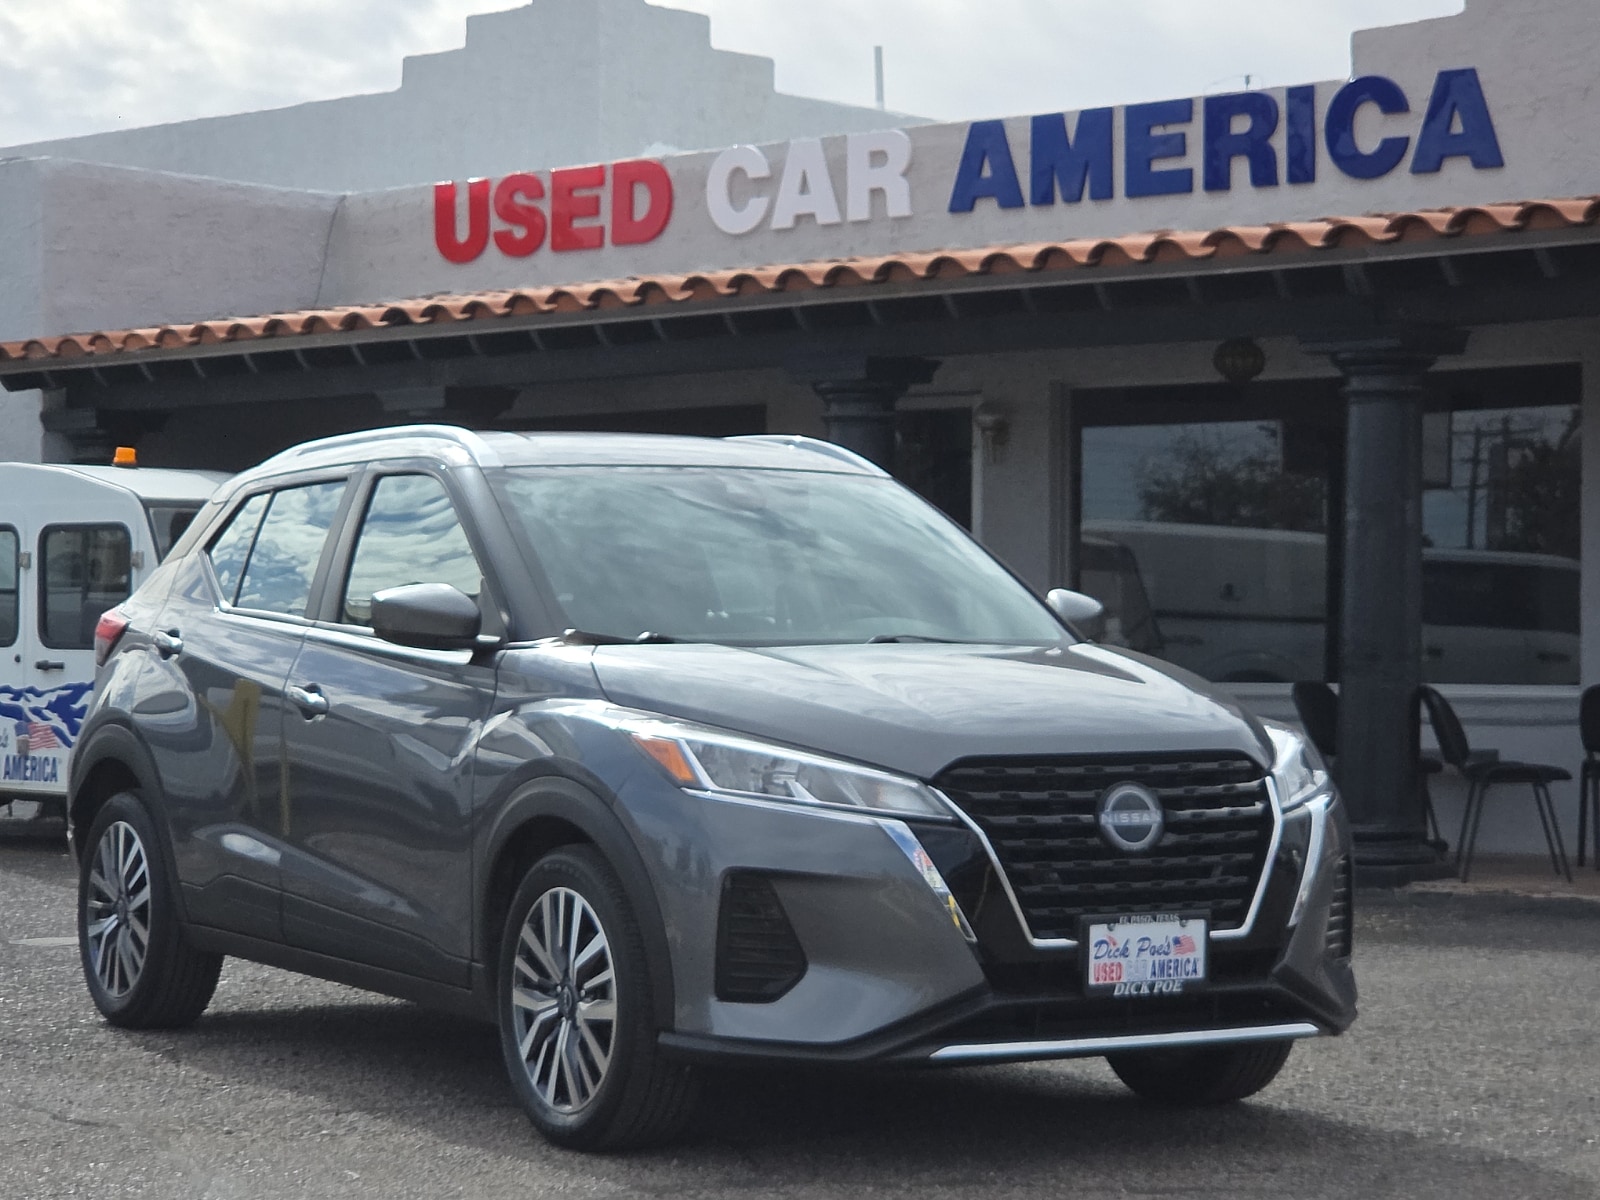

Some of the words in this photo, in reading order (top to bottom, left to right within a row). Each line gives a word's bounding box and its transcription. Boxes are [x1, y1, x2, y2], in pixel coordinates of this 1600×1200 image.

[434, 158, 674, 265] USED
[706, 128, 913, 235] CAR
[948, 67, 1505, 214] AMERICA
[3, 754, 58, 783] AMERICA
[1101, 812, 1161, 824] NISSAN
[1094, 938, 1129, 960] Dick
[1136, 935, 1172, 957] Poe's
[1094, 961, 1123, 983] USED
[1150, 957, 1198, 979] AMERICA
[1113, 981, 1151, 996] DICK
[1153, 979, 1184, 993] POE
